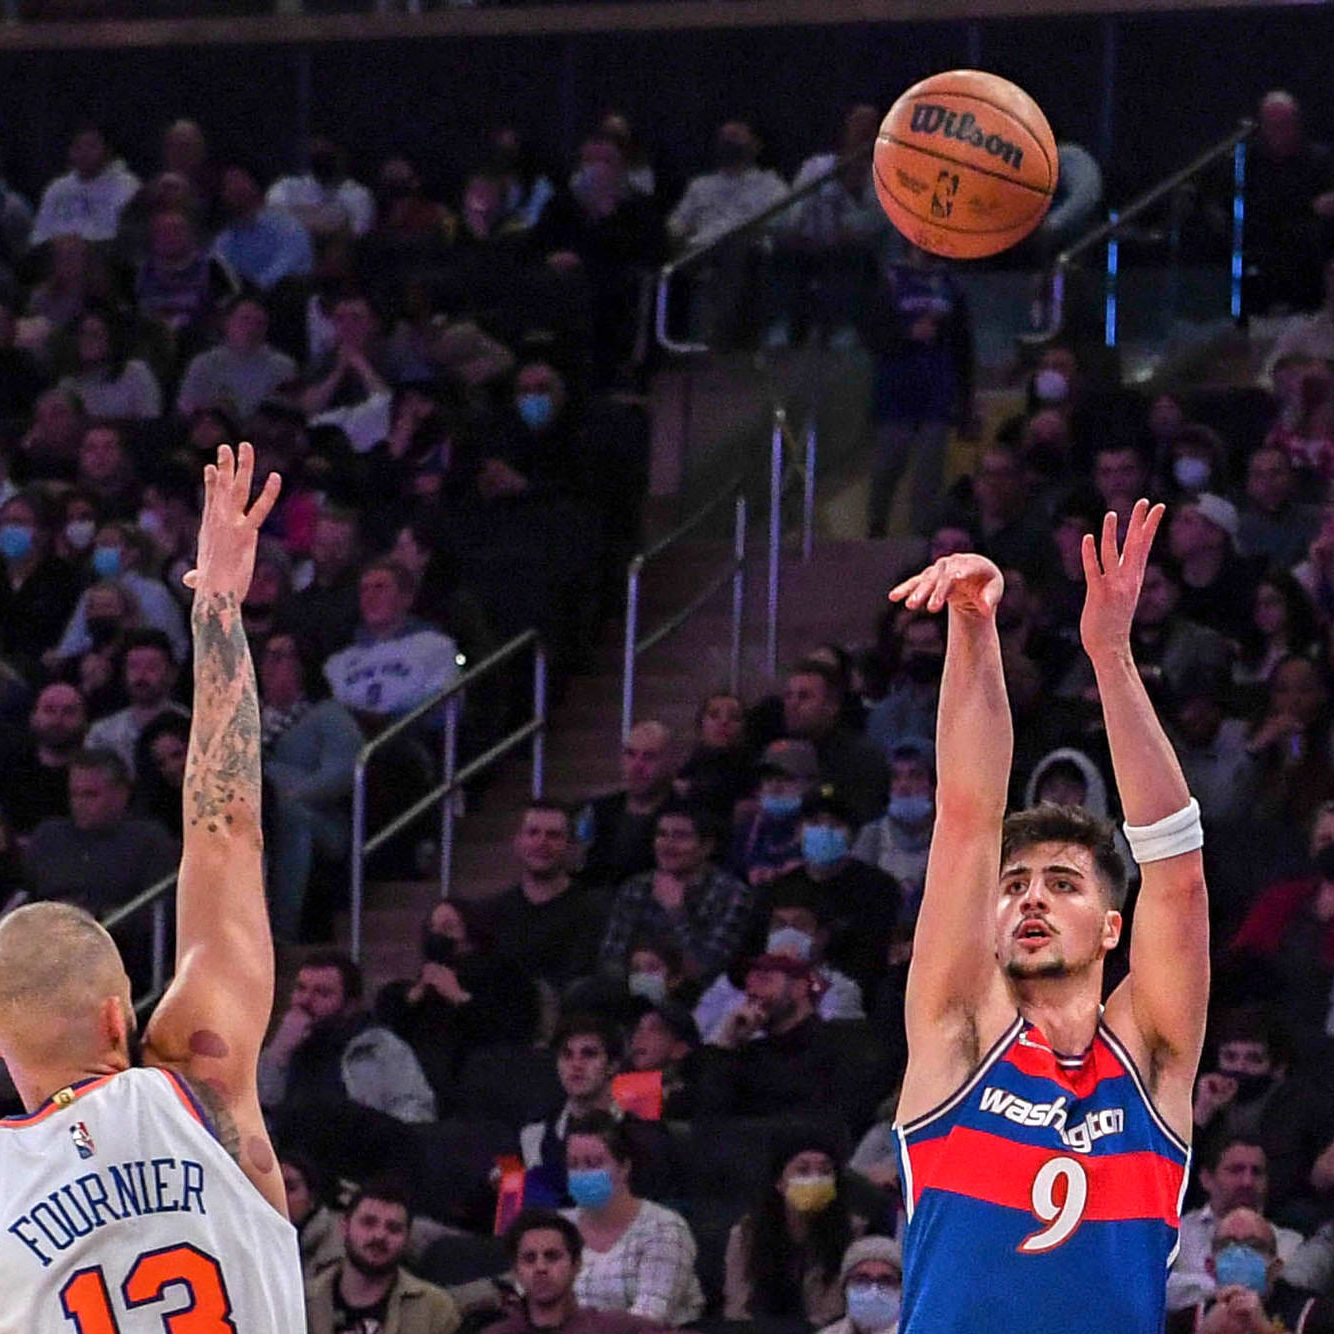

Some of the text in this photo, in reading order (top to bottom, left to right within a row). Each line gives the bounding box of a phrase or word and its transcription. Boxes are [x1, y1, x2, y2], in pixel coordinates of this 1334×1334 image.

[909, 102, 1025, 171] Wilson
[8, 1158, 207, 1267] FOURNIER
[1016, 1155, 1089, 1254] 9
